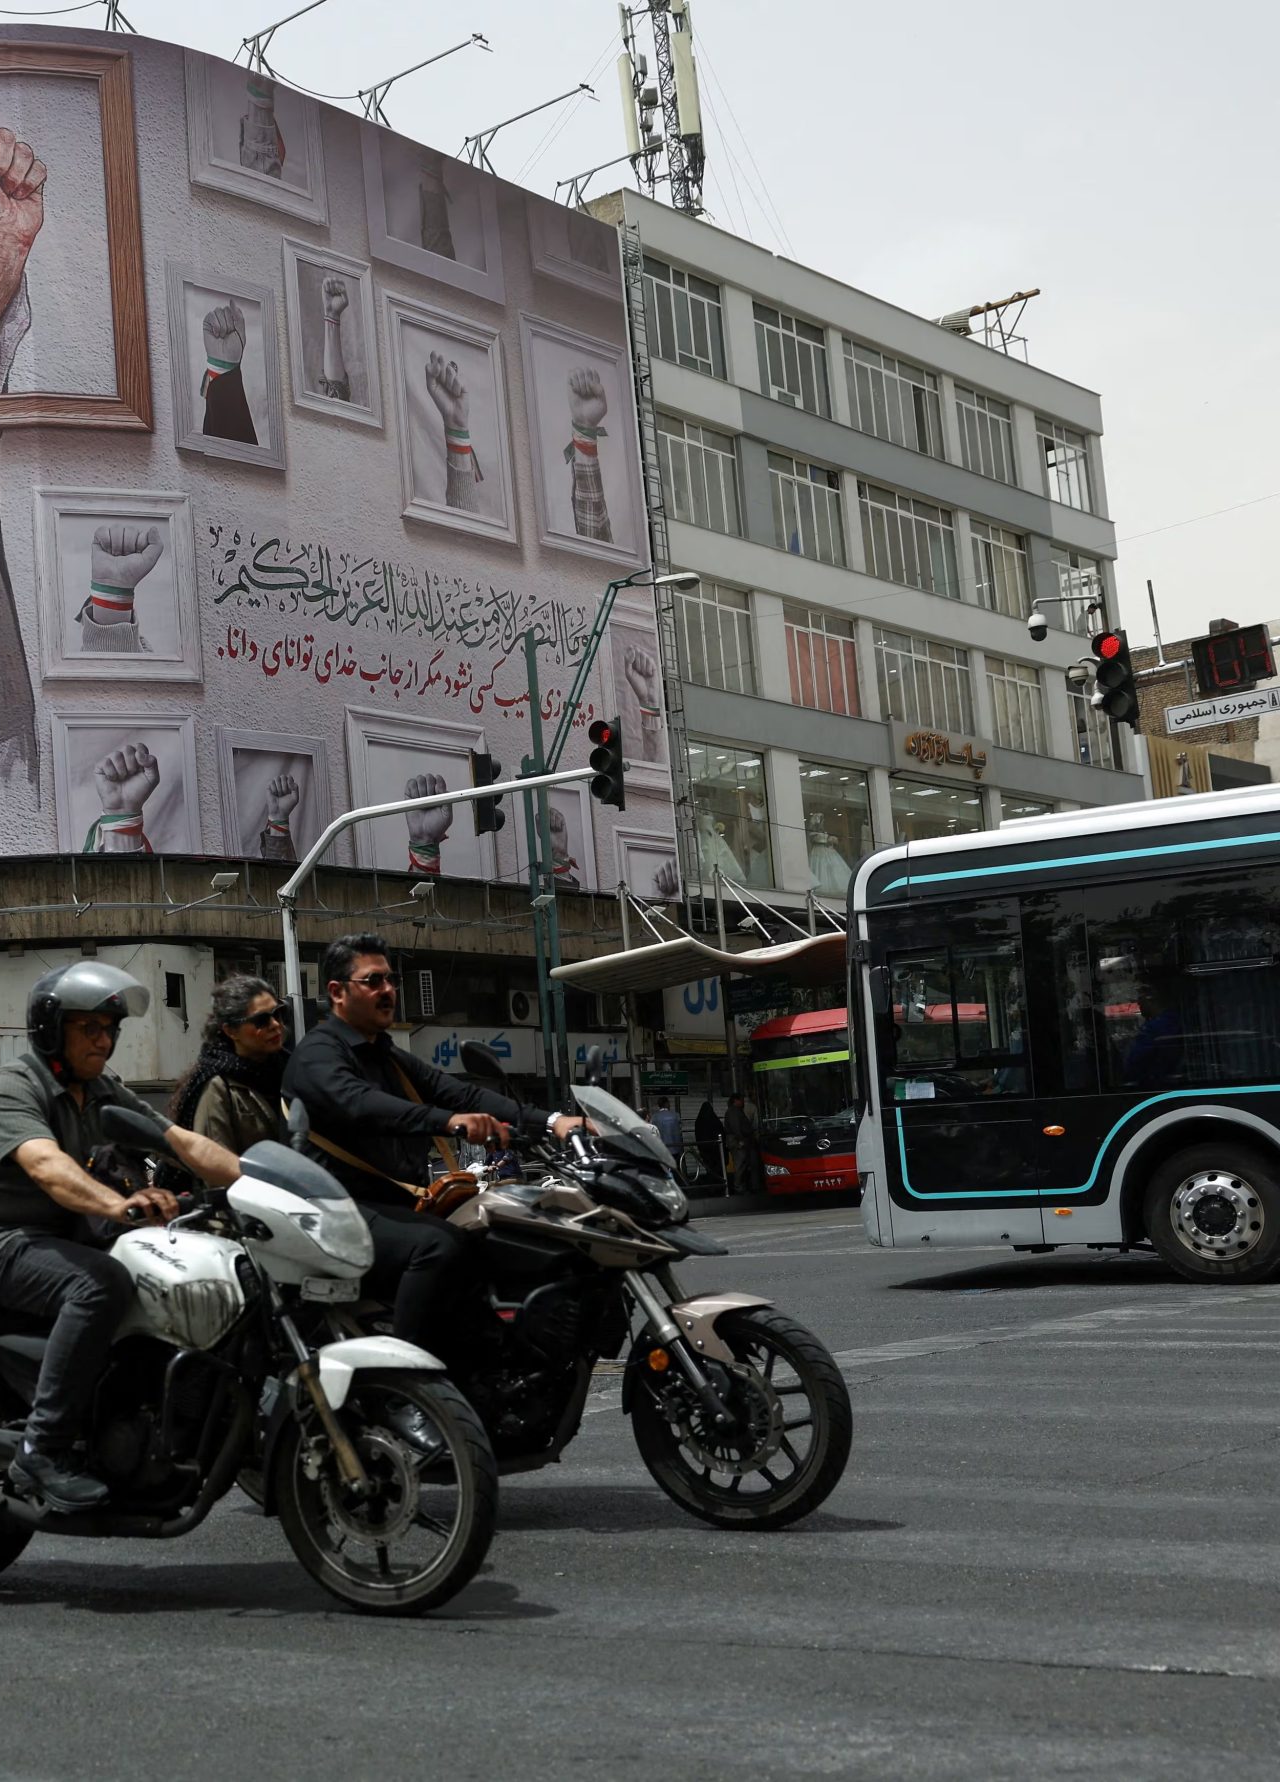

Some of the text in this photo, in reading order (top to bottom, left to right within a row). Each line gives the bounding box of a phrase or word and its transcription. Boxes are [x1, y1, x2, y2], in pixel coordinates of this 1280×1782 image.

[261, 632, 315, 678] توانای
[314, 641, 358, 684] خدای
[359, 651, 404, 700] جانب
[404, 658, 419, 690] از
[417, 648, 445, 696] مگر
[444, 661, 473, 698] نشود
[470, 656, 507, 714] کسی
[1174, 696, 1268, 725] جمهوری اسلامی
